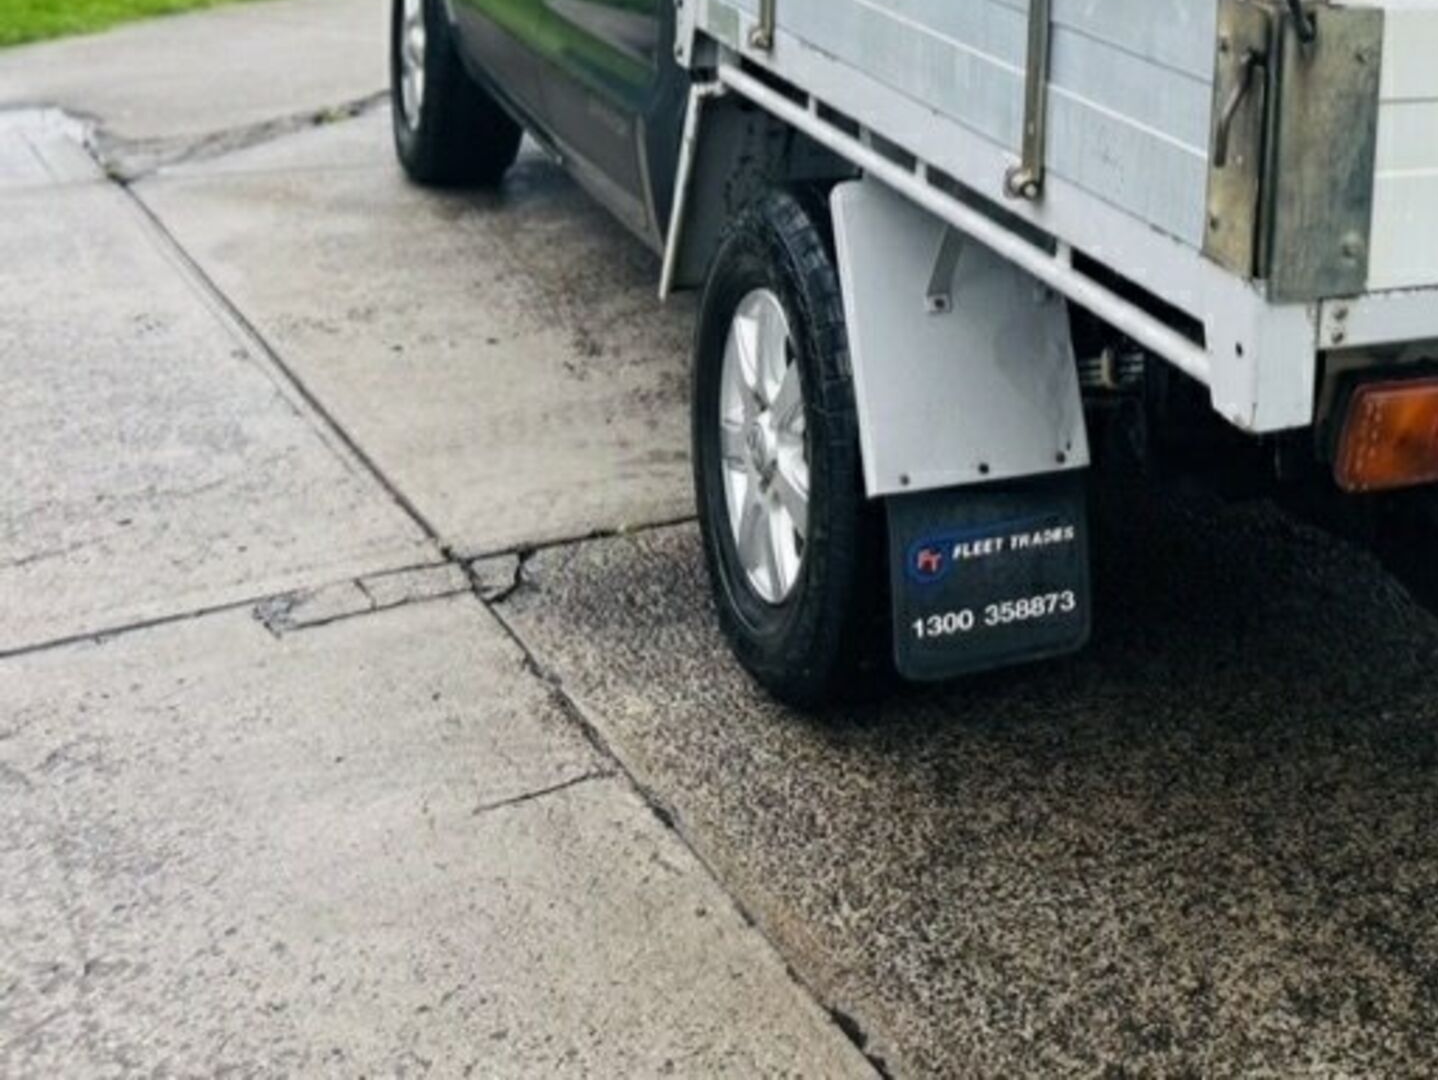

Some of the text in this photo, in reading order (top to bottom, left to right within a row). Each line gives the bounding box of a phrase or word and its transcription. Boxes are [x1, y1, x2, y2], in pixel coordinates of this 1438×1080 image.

[953, 536, 1002, 559] FLEET
[1011, 525, 1075, 549] TRADES
[913, 590, 1076, 639] 1300 358873
